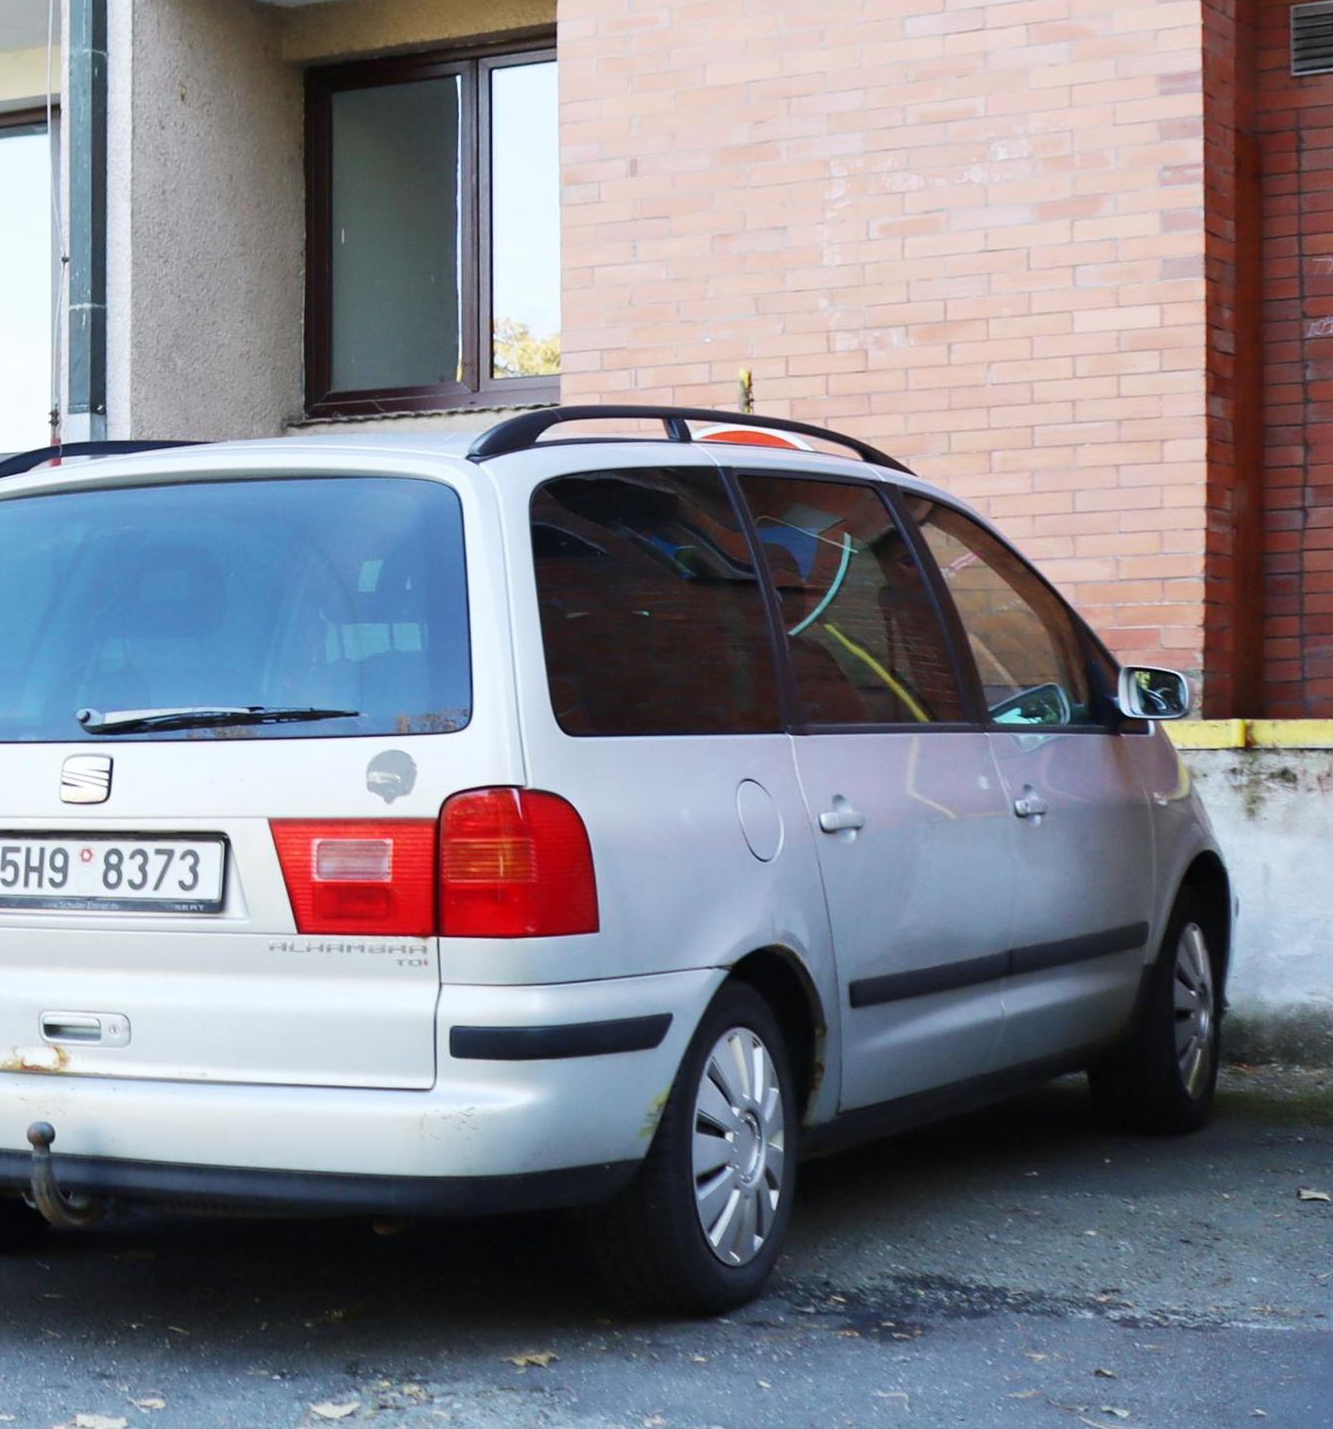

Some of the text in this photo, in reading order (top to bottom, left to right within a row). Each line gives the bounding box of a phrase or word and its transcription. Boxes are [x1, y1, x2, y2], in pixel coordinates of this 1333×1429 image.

[0, 846, 201, 892] 5H9 8373
[269, 941, 429, 955] ALHAMBRA
